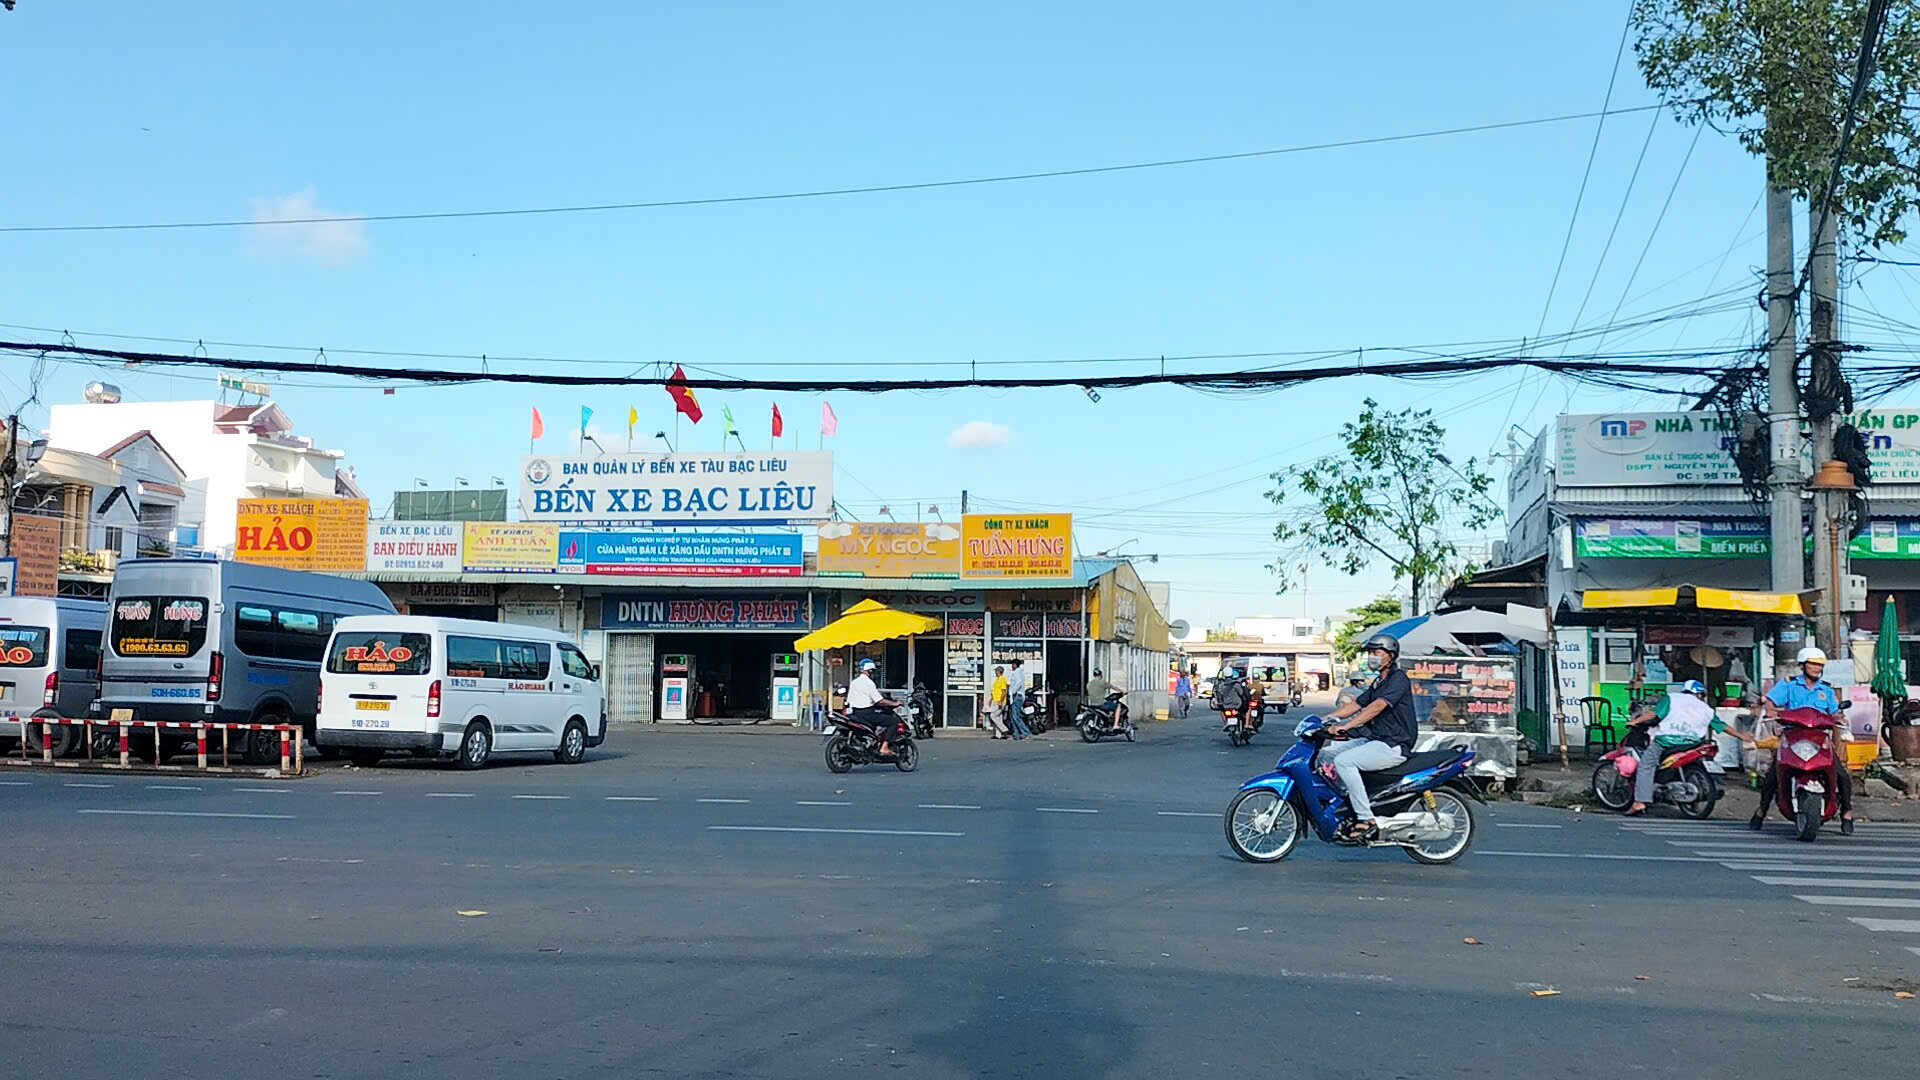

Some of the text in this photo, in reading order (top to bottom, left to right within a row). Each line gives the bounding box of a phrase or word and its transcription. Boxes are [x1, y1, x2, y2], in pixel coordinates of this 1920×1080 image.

[563, 457, 787, 475] BAN QUẢN LÝ BẾN XE TÀU BẠC LIÊU
[533, 478, 816, 518] BẾN XE BẠC LIÊU
[237, 516, 313, 551] HẢO
[379, 525, 397, 536] BẾN
[400, 527, 412, 535] XE
[433, 525, 453, 536] LIÊU
[373, 542, 396, 556] BAN
[427, 539, 457, 556] HÀNH
[967, 530, 1065, 557] TUẤN HƯNG
[618, 601, 664, 622] DNTN
[738, 593, 798, 623] PHÁT
[345, 641, 412, 662] HẢO
